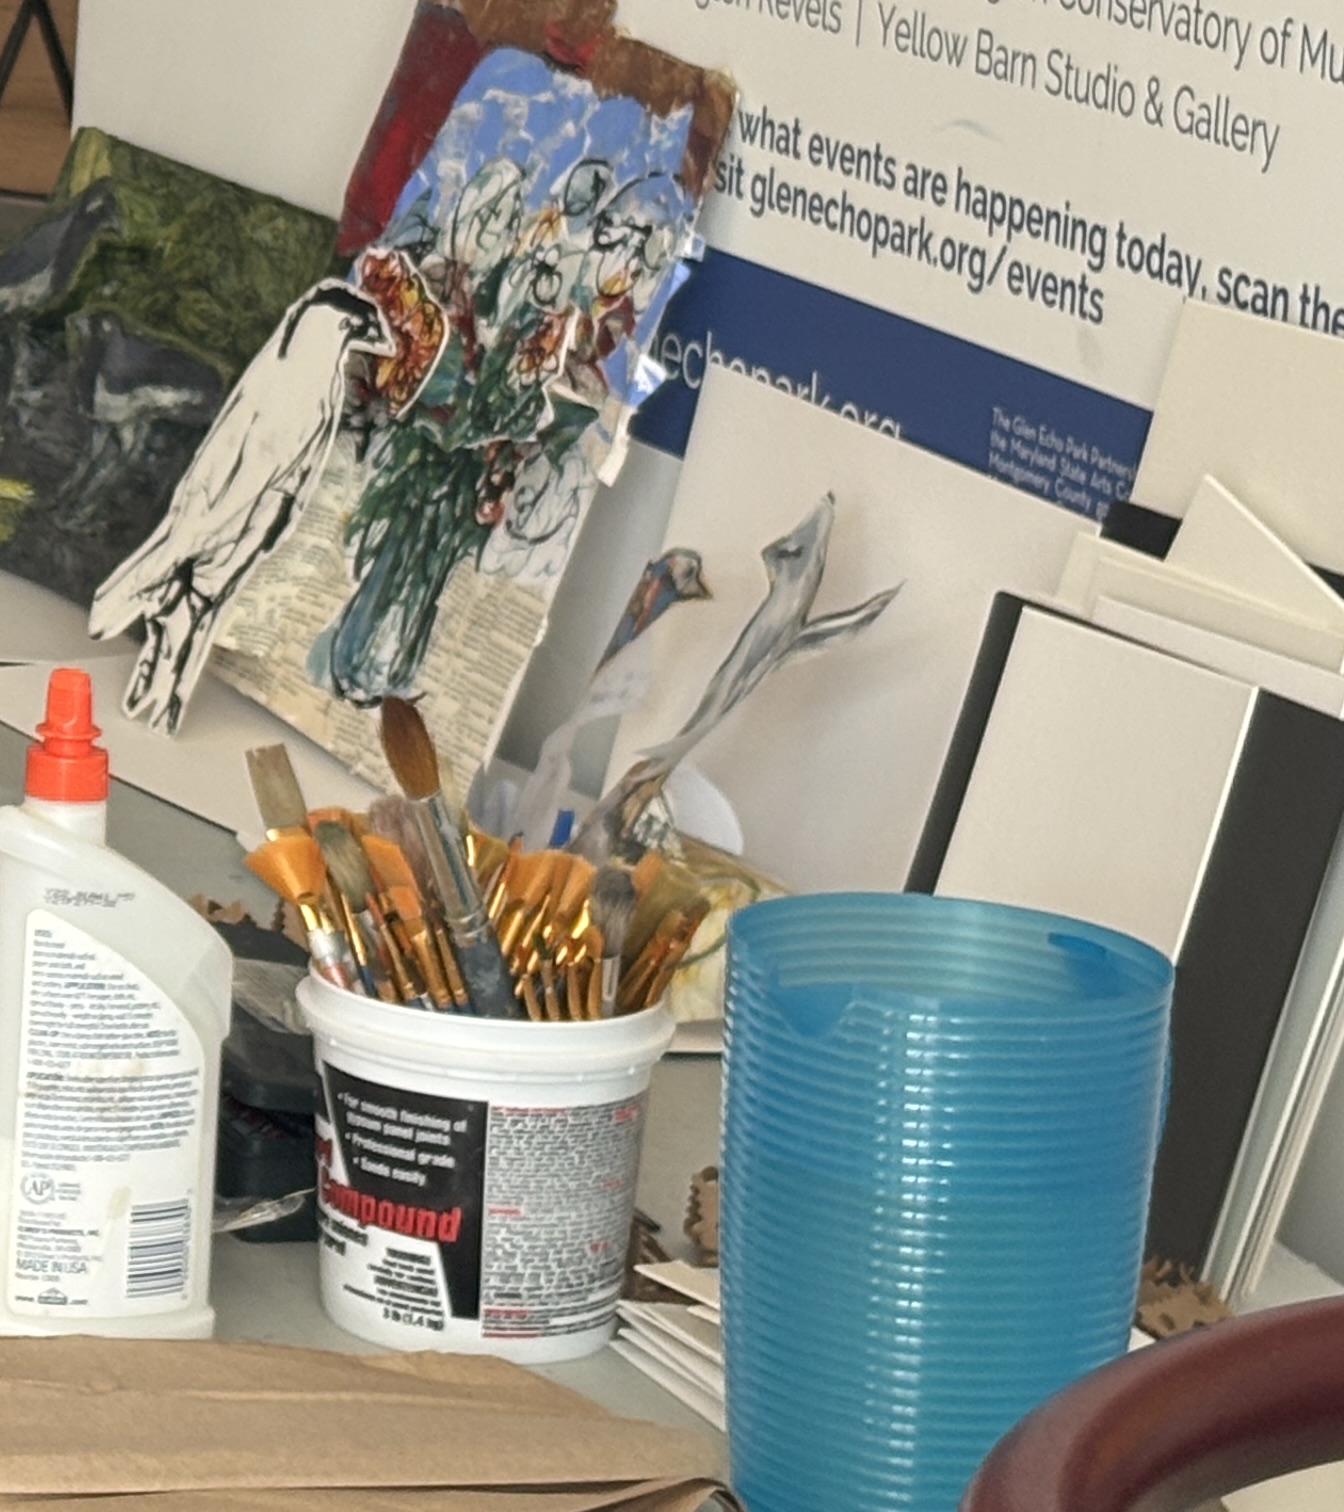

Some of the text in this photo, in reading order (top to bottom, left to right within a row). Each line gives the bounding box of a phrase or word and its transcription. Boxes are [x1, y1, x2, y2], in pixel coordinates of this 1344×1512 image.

[878, 2, 968, 68] Yellow
[975, 28, 1037, 89] Barn
[1045, 48, 1135, 118] Studio
[1144, 75, 1163, 127] &
[1174, 85, 1280, 174] Gallery
[1260, 17, 1294, 68] of
[1300, 24, 1344, 85] Mu
[714, 153, 1106, 325] sit glenechopark.org/events
[738, 105, 802, 160] what
[808, 133, 896, 190] events
[903, 163, 948, 207] are
[954, 166, 1107, 273] happening
[1216, 266, 1289, 322] scan
[16, 1258, 49, 1273] MADE
